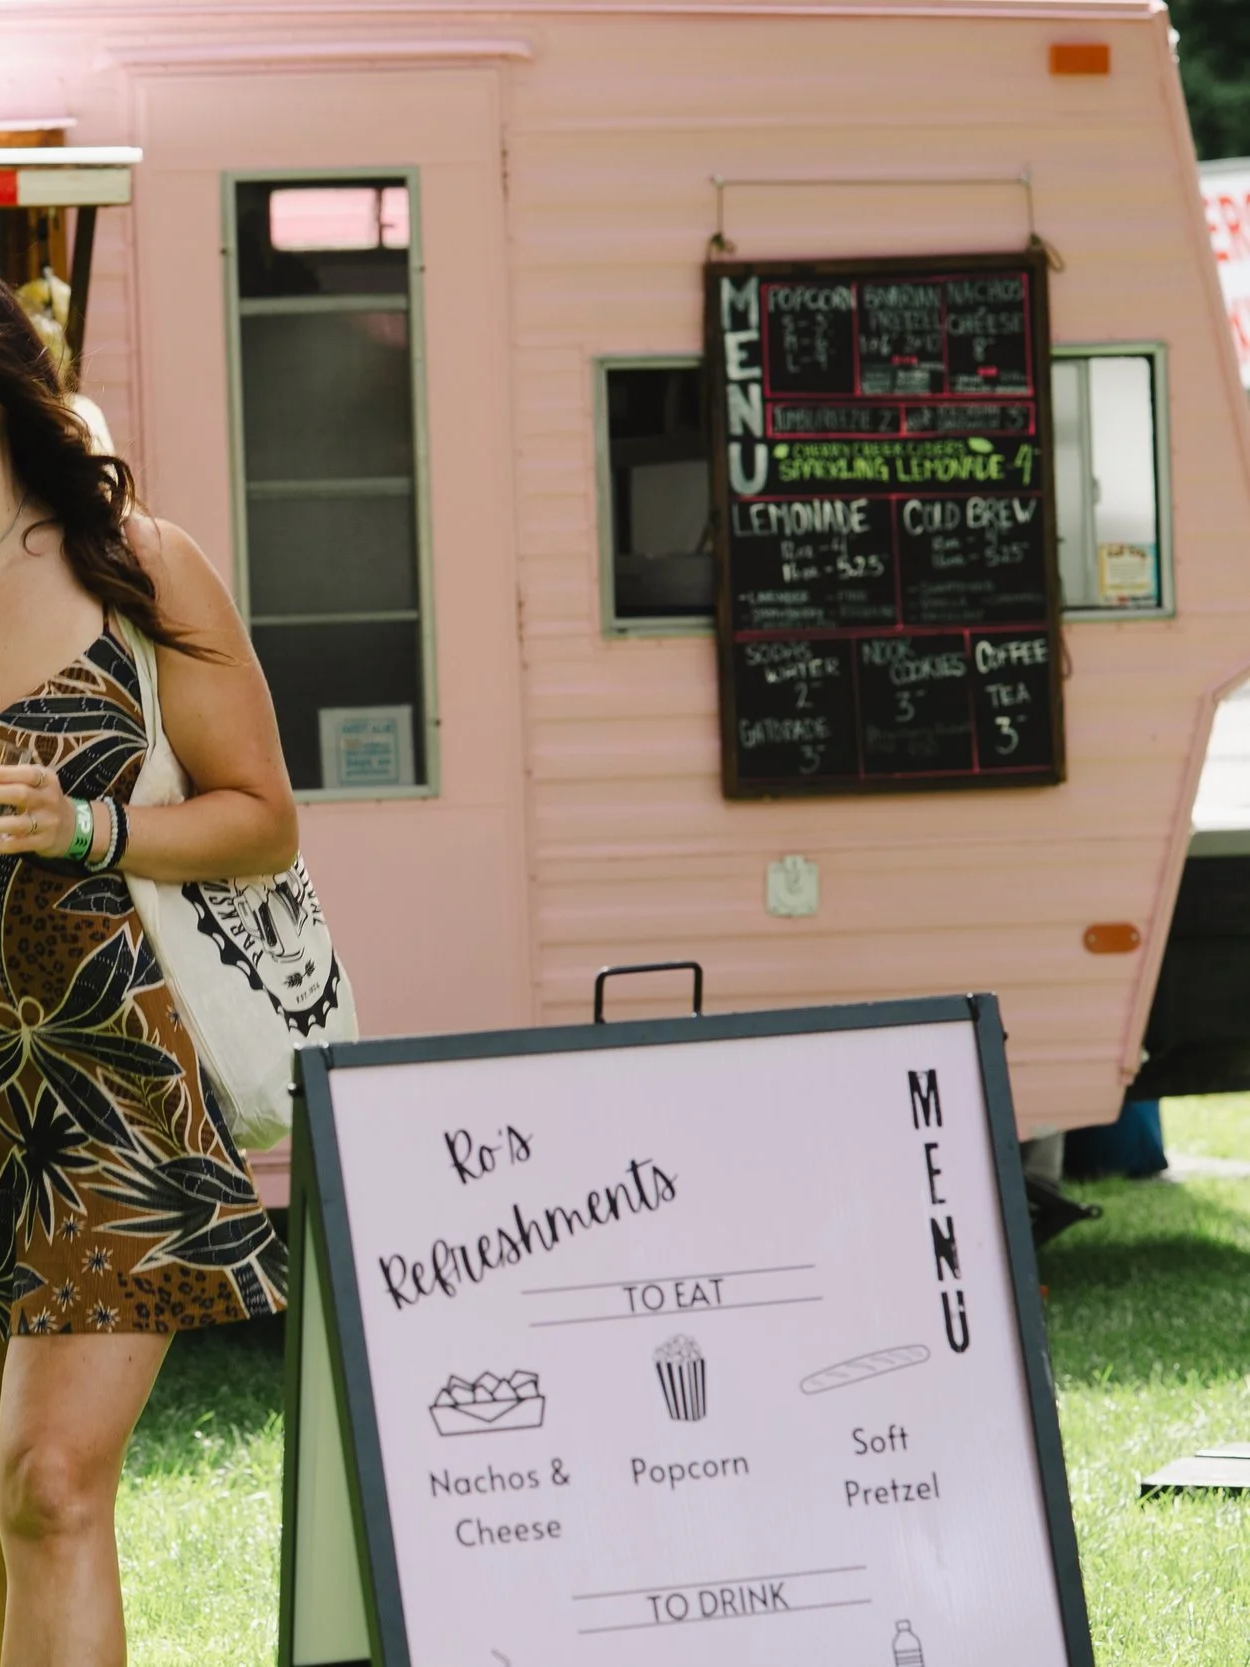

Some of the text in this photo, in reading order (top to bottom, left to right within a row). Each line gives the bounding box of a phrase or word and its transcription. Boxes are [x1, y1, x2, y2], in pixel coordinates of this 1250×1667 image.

[767, 284, 856, 312] POPCORN
[720, 276, 768, 495] MENU
[732, 498, 871, 537] LEMONADE
[903, 495, 1038, 535] COLD BREW
[975, 639, 1049, 673] COFFEE
[985, 683, 1032, 708] TEA
[444, 1125, 535, 1186] Ro's
[908, 1069, 970, 1353] MENU
[377, 1156, 679, 1311] Refreshments
[623, 1278, 725, 1313] TO EAT
[852, 1425, 909, 1458] Soft
[429, 1457, 572, 1498] Nachos &
[631, 1453, 750, 1489] Popcorn
[844, 1472, 941, 1508] Pretzel
[455, 1514, 562, 1549] Cheese
[647, 1582, 792, 1625] TO DRINK
